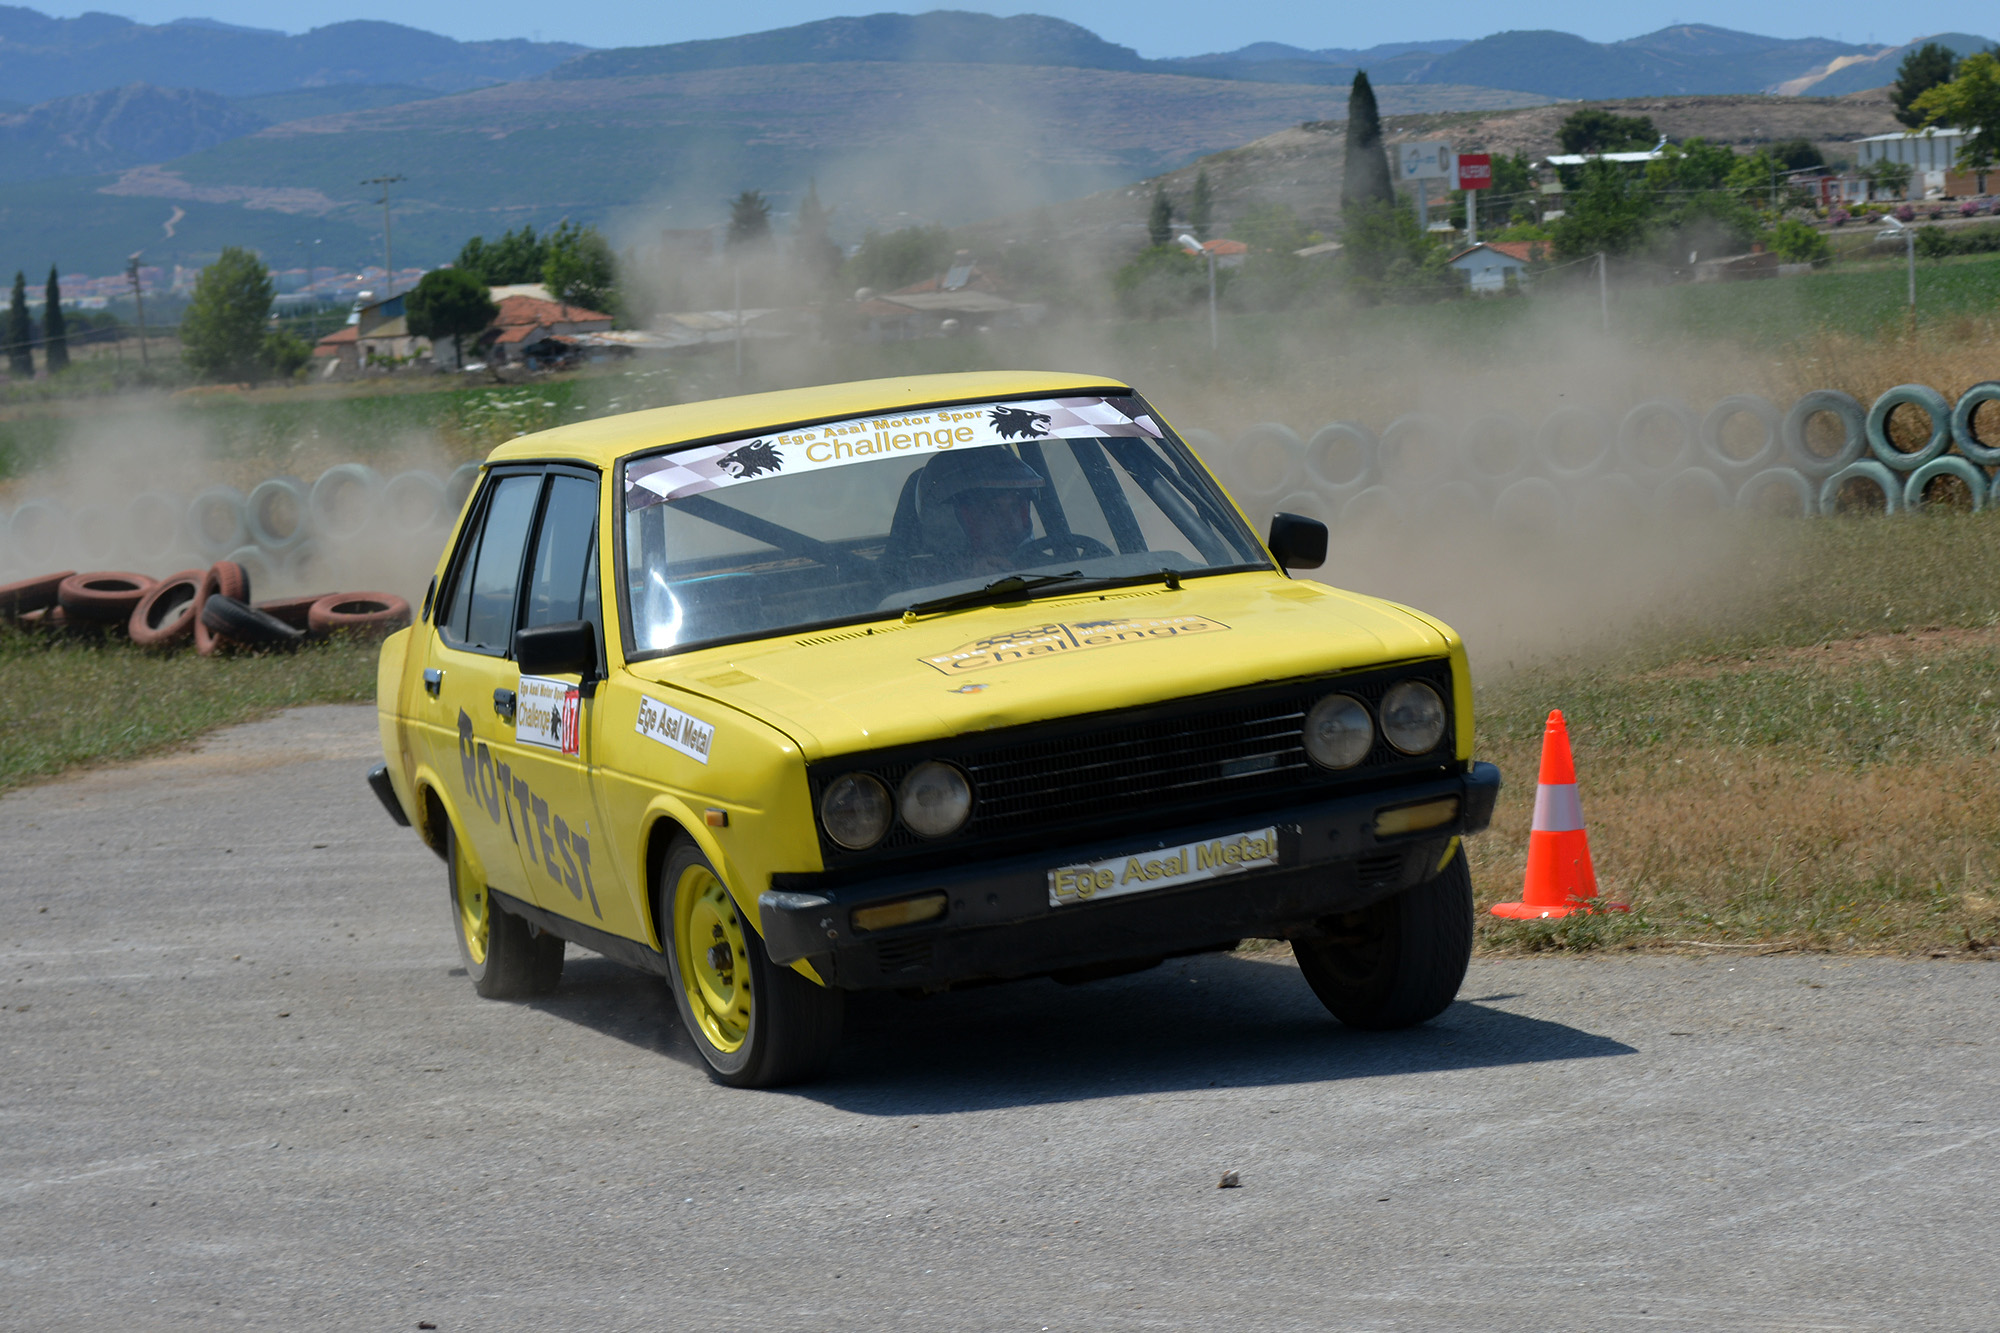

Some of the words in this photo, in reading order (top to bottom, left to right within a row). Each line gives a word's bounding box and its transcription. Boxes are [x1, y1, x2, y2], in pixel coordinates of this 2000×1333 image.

[778, 433, 816, 445] Ege
[824, 422, 867, 438] Asal
[872, 416, 931, 430] Motor
[938, 411, 982, 422] Spor
[805, 426, 974, 462] Challenge
[519, 701, 550, 736] Challenge
[637, 698, 657, 734] Ege
[656, 708, 683, 742] Asal
[681, 717, 713, 755] Metal
[457, 706, 604, 921] ROTTEST
[1054, 868, 1114, 899] Ege
[1121, 847, 1189, 885] Asal
[1196, 829, 1275, 870] Metal
